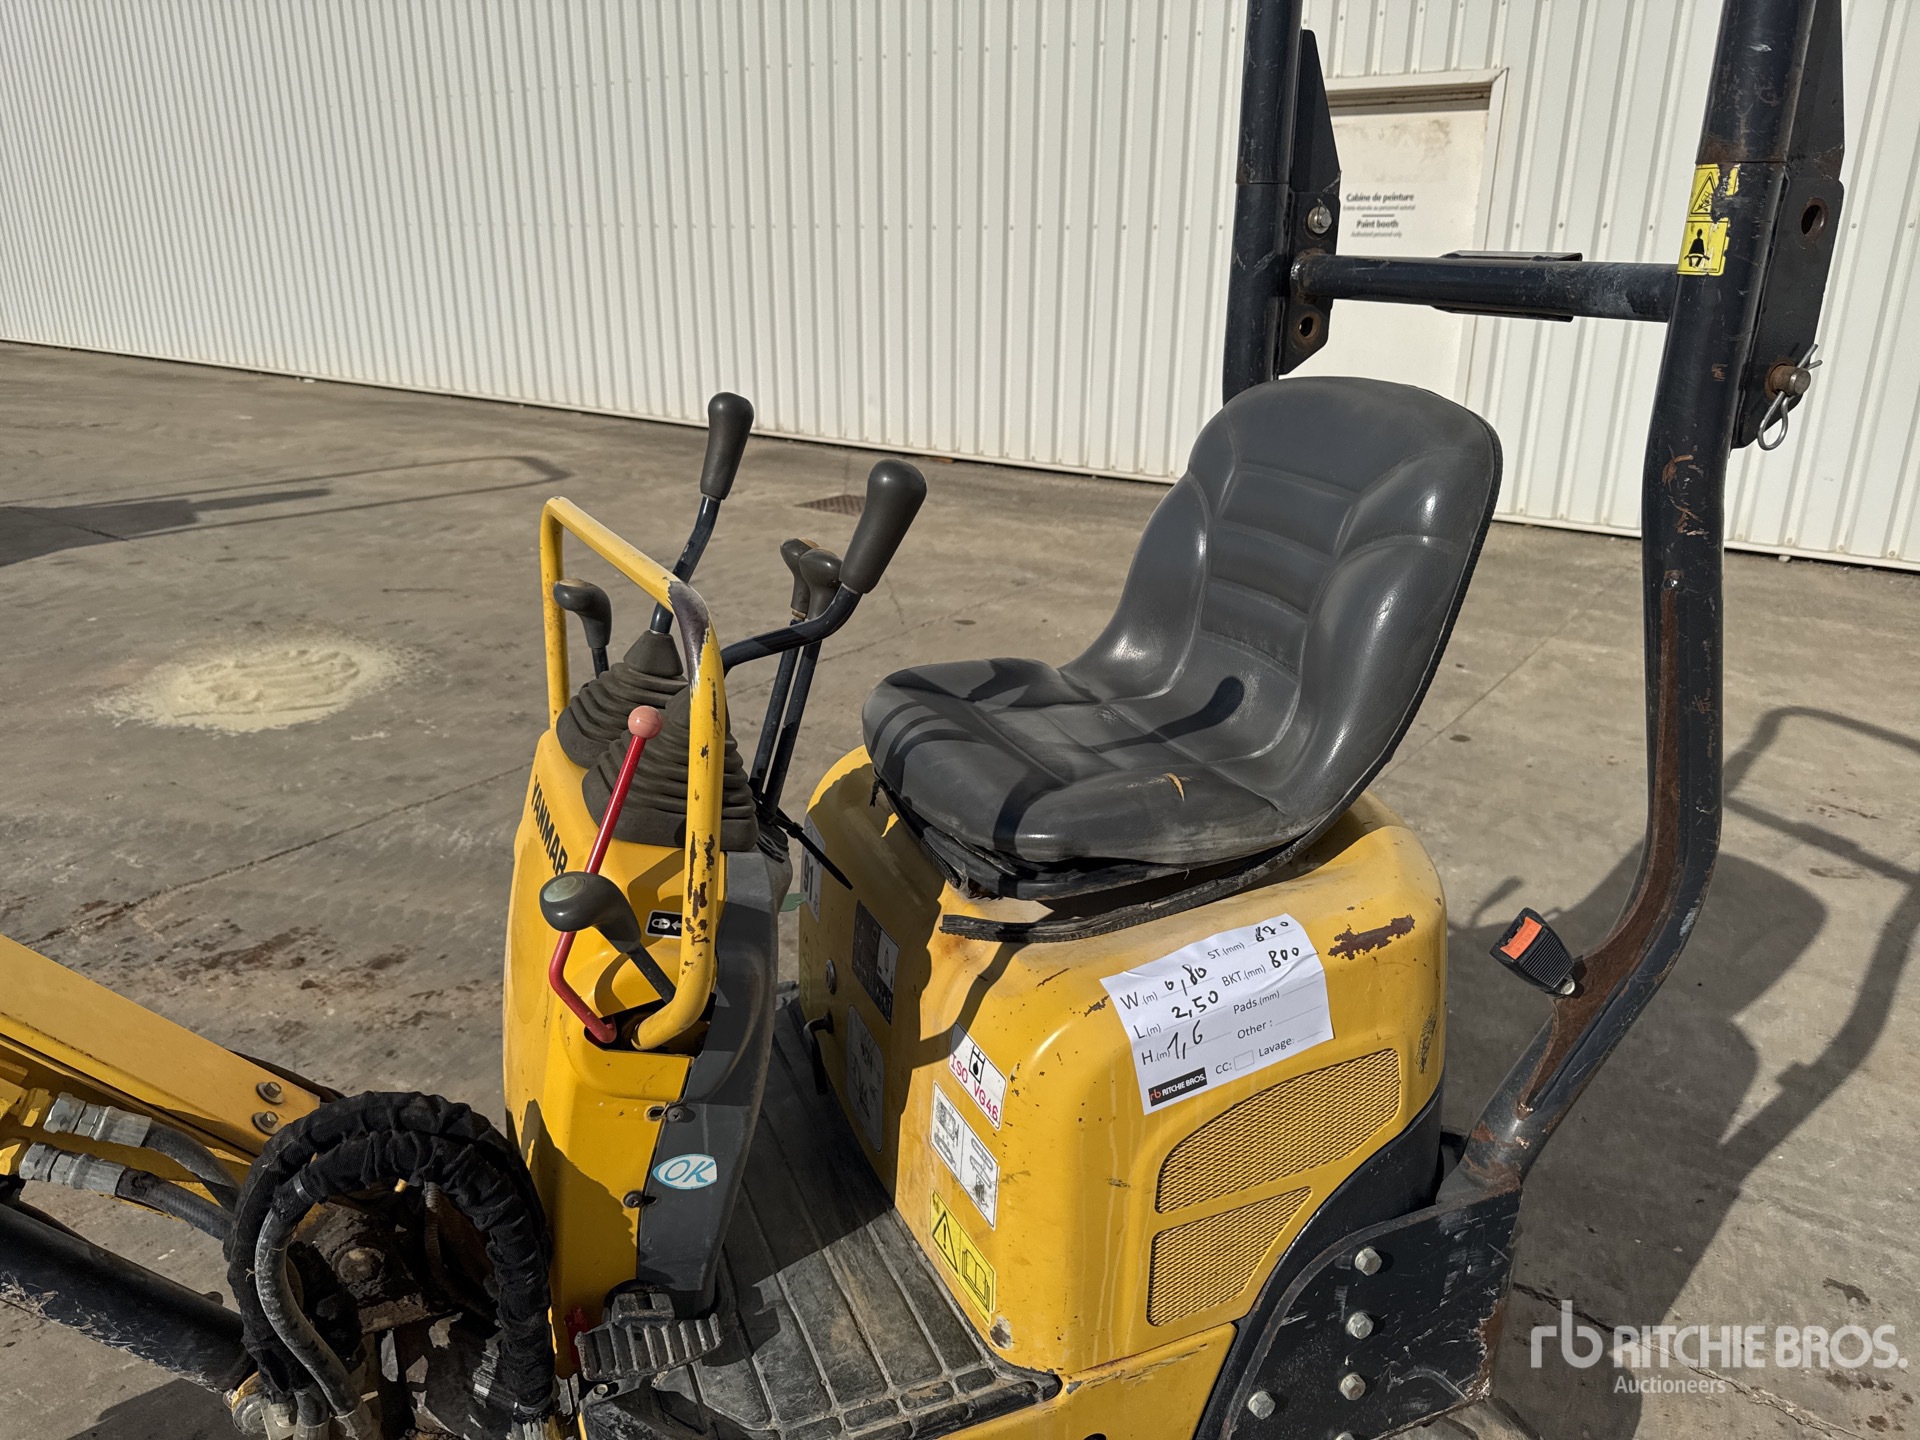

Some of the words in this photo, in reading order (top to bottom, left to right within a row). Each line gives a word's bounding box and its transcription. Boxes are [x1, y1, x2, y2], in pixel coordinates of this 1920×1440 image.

[1346, 192, 1371, 202] Cabine
[1372, 192, 1381, 201] de
[1382, 193, 1414, 203] peinture
[1356, 220, 1375, 228] Paint
[1377, 220, 1398, 228] booth
[531, 774, 568, 876] YANMAR
[1268, 947, 1299, 969] 800
[1171, 990, 1219, 1018] 2,50
[1237, 1021, 1266, 1040] Other
[1215, 1062, 1232, 1075] CC:
[1258, 1037, 1294, 1057] Lavage:
[950, 1053, 968, 1083] ISO
[973, 1081, 998, 1121] VG46
[1162, 1080, 1185, 1097] RITCHIE
[664, 1159, 715, 1183] OK
